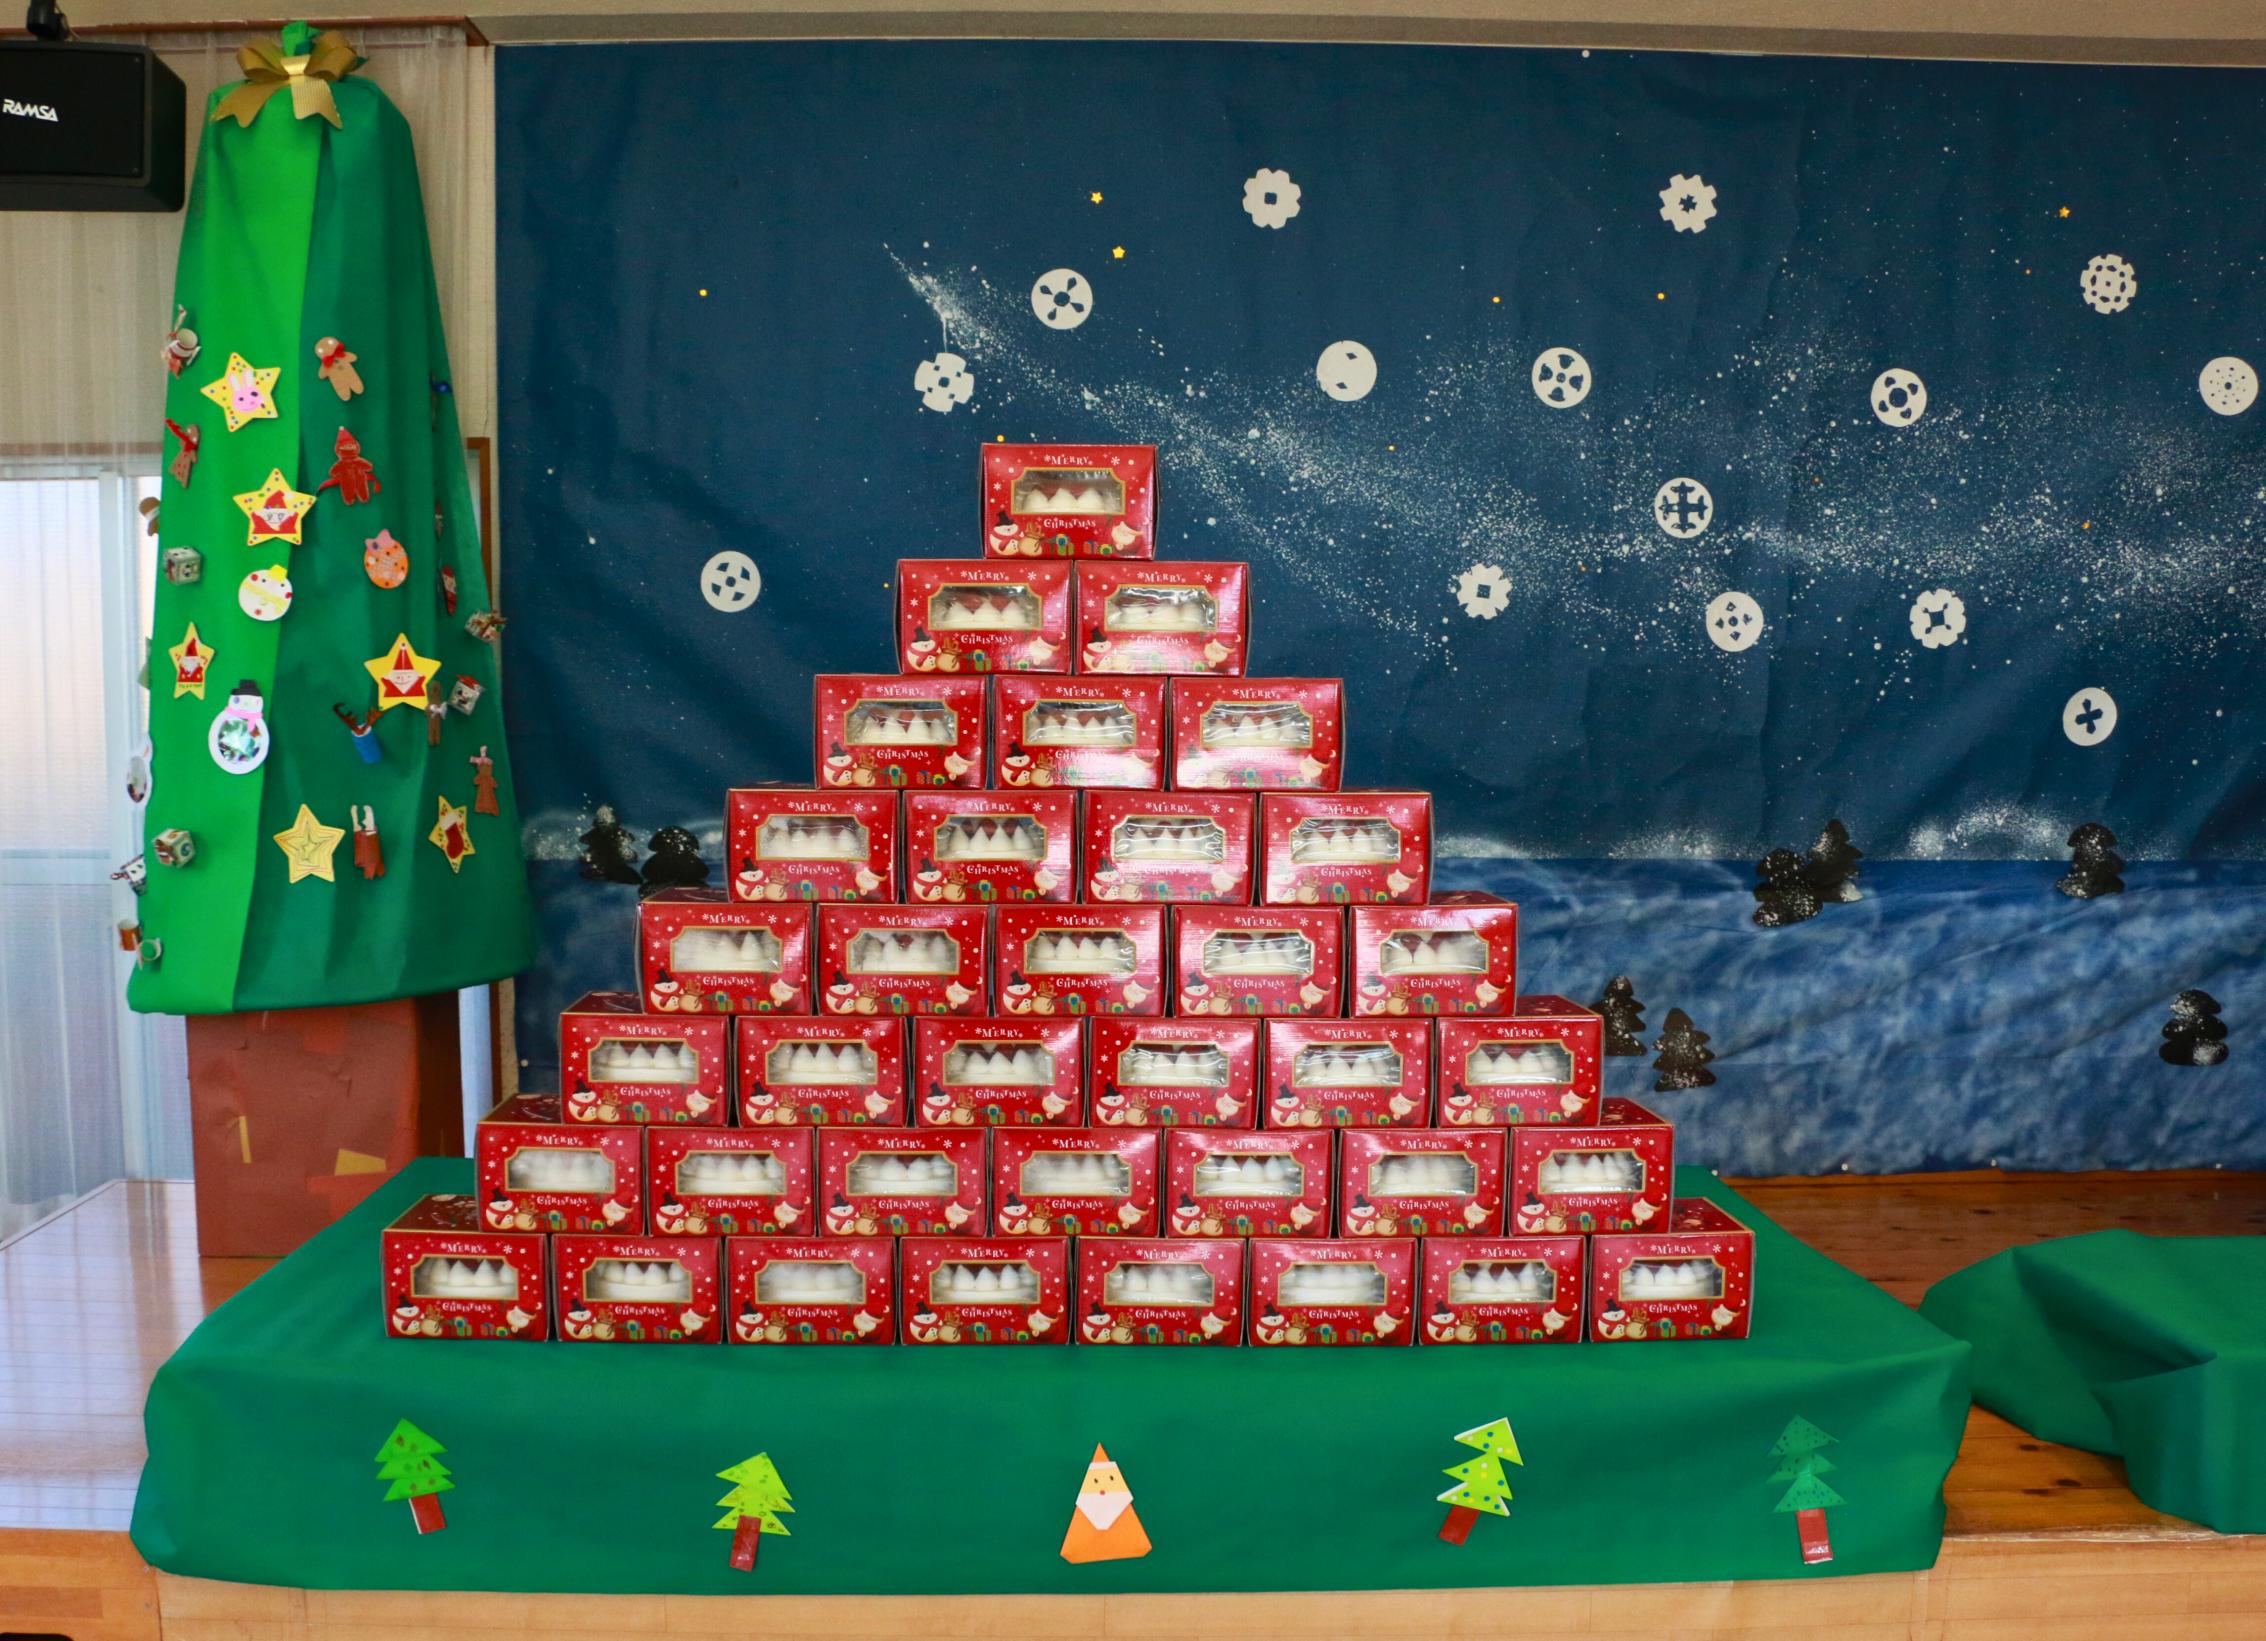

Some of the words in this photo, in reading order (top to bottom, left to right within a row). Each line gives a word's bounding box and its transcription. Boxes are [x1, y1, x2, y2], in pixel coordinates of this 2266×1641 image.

[3, 99, 58, 122] RAMSA
[1050, 456, 1088, 466] MERRY
[1044, 517, 1096, 529] CHRISTMAS
[968, 572, 1004, 582] MERRY
[1144, 572, 1180, 584] MERRY
[960, 633, 1014, 645] CHRISTMAS
[882, 686, 920, 698] MERRY
[1062, 688, 1100, 698] MERRY
[1238, 690, 1276, 700] MERRY
[876, 748, 930, 760] CHRISTMAS
[795, 803, 831, 813] MERRY
[974, 803, 1010, 813] MERRY
[1152, 804, 1188, 814] MERRY
[1328, 805, 1364, 815] MERRY
[788, 863, 840, 875] CHRISTMAS
[967, 863, 1019, 875] CHRISTMAS
[1320, 866, 1372, 878] CHRISTMAS
[709, 915, 745, 925] MERRY
[885, 917, 921, 927] MERRY
[1063, 917, 1099, 927] MERRY
[1241, 918, 1277, 928] MERRY
[702, 975, 754, 987] CHRISTMAS
[879, 977, 931, 989] CHRISTMAS
[1056, 977, 1108, 989] CHRISTMAS
[1233, 977, 1285, 989] CHRISTMAS
[1410, 977, 1462, 989] CHRISTMAS
[626, 1026, 662, 1036] MERRY
[804, 1028, 840, 1038] MERRY
[982, 1029, 1018, 1039] MERRY
[1157, 1029, 1193, 1039] MERRY
[1331, 1030, 1367, 1040] MERRY
[1503, 1028, 1539, 1038] MERRY
[619, 1086, 671, 1098] CHRISTMAS
[798, 1087, 850, 1099] CHRISTMAS
[975, 1088, 1027, 1100] CHRISTMAS
[1149, 1089, 1201, 1101] CHRISTMAS
[1323, 1089, 1375, 1101] CHRISTMAS
[1495, 1087, 1547, 1099] CHRISTMAS
[542, 1136, 578, 1146] MERRY
[713, 1139, 749, 1149] MERRY
[885, 1140, 921, 1150] MERRY
[1059, 1140, 1095, 1150] MERRY
[1233, 1141, 1269, 1151] MERRY
[1407, 1140, 1443, 1150] MERRY
[1576, 1138, 1612, 1148] MERRY
[537, 1195, 587, 1207] CHRISTMAS
[708, 1197, 758, 1209] CHRISTMAS
[879, 1198, 929, 1210] CHRISTMAS
[1052, 1198, 1102, 1210] CHRISTMAS
[1225, 1199, 1275, 1211] CHRISTMAS
[1399, 1199, 1449, 1211] CHRISTMAS
[1568, 1196, 1618, 1208] CHRISTMAS
[447, 1243, 481, 1253] MERRY
[621, 1247, 655, 1257] MERRY
[1488, 1248, 1522, 1258] MERRY
[1657, 1245, 1691, 1255] MERRY
[794, 1249, 828, 1259] MERRY
[969, 1249, 1003, 1259] MERRY
[1144, 1250, 1178, 1260] MERRY
[1317, 1250, 1351, 1260] MERRY
[442, 1302, 492, 1312] CHRISTMAS
[615, 1305, 665, 1315] CHRISTMAS
[788, 1307, 838, 1317] CHRISTMAS
[962, 1307, 1012, 1317] CHRISTMAS
[1479, 1306, 1529, 1316] CHRISTMAS
[1648, 1303, 1698, 1313] CHRISTMAS
[1135, 1309, 1185, 1319] CHRISTMAS
[1309, 1309, 1359, 1319] CHRISTMAS
